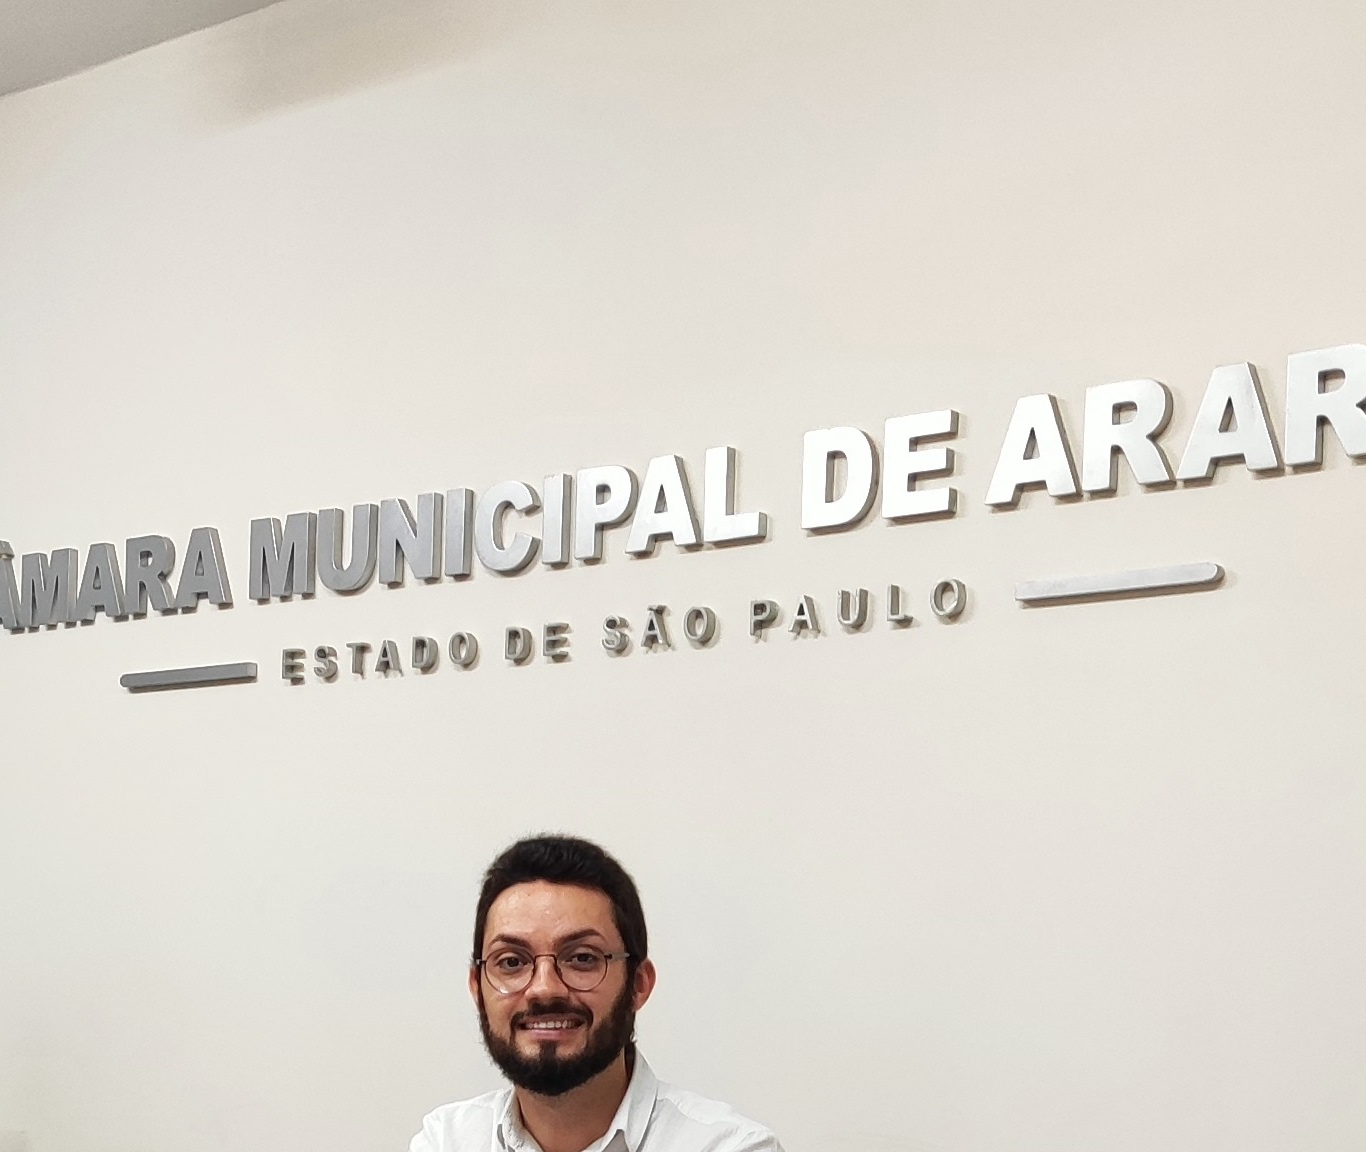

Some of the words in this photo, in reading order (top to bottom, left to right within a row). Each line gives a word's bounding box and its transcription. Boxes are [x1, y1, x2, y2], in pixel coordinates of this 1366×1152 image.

[248, 446, 769, 604] MUNICIPAL
[800, 409, 961, 534] DE
[280, 631, 480, 686] ESTADO
[504, 620, 573, 666] DE
[601, 604, 722, 652] SÃO
[749, 577, 971, 639] PAULO
